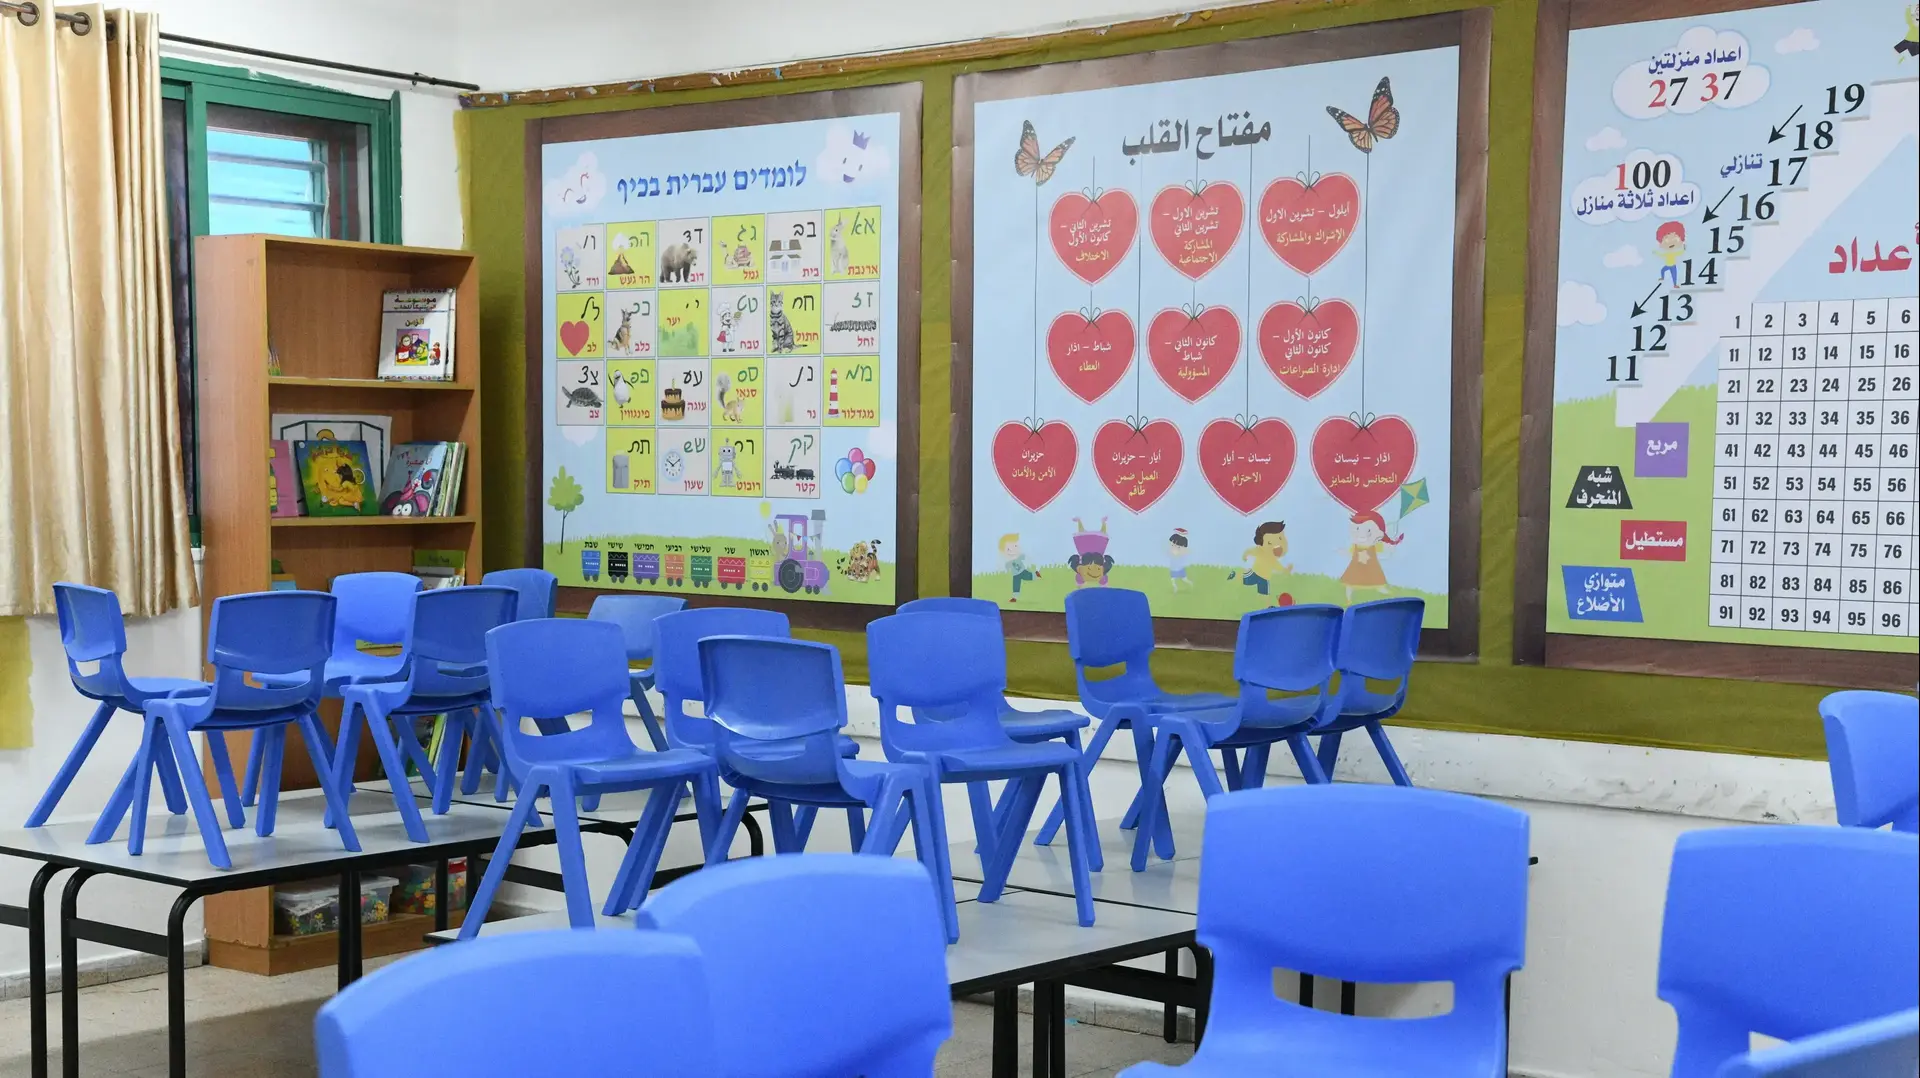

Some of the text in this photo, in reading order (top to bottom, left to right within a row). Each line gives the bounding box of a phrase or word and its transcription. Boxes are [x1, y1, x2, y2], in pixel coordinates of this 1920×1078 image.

[1648, 46, 1742, 75] اعداد منزلتين
[1648, 70, 1742, 108] 27 37
[1823, 83, 1866, 116] 19
[1122, 110, 1271, 166] مفتاح القلب
[1793, 120, 1834, 152] 18
[1719, 153, 1764, 178] تنازلي
[1767, 156, 1808, 187] 17
[617, 159, 807, 205] לומדים עברית בכיף
[1614, 160, 1672, 191] 100
[1576, 196, 1614, 216] منازل
[1617, 190, 1654, 210] ثلاثة
[1737, 191, 1775, 222] 16
[1174, 221, 1193, 238] الثاني
[1707, 225, 1745, 255] 15
[690, 272, 705, 283] דוב
[743, 269, 760, 280] גמל
[802, 267, 820, 278] בית
[847, 264, 879, 276] ארנבת
[1680, 257, 1719, 287] 14
[586, 277, 600, 286] ורד
[619, 276, 651, 286] הר געש
[1657, 293, 1694, 322] 13
[666, 316, 682, 327] יער
[1735, 310, 1911, 329] 1 2 3 4 5 6
[739, 339, 760, 350] טבח
[795, 330, 820, 343] חתול
[857, 335, 875, 348] זחל
[1174, 334, 1218, 352] كانون الثاني
[1307, 328, 1331, 344] كانون
[1630, 324, 1668, 352] 12
[586, 343, 597, 353] לב
[634, 341, 651, 352] כלב
[1092, 340, 1113, 353] شباط
[1285, 342, 1331, 360] كانون الثاني
[1729, 344, 1910, 362] 11 12 13 14 15 16
[1182, 350, 1203, 362] شباط
[1079, 360, 1100, 372] العطاء
[1605, 355, 1640, 382] 11
[735, 388, 757, 398] סנאי
[1727, 377, 1911, 394] 21 22 23 24 25 26
[589, 409, 600, 419] צב
[619, 409, 651, 421] פינגווין
[686, 402, 707, 412] עוגה
[806, 410, 817, 420] נר
[841, 407, 875, 420] מגדלור
[1725, 411, 1910, 426] 31 32 33 34 35 36
[1021, 450, 1045, 463] حزيران
[1646, 439, 1678, 457] مربع
[1724, 444, 1909, 459] 41 42 43 44 45 46
[1248, 453, 1272, 465] نيسان
[1334, 453, 1360, 467] نيسان
[633, 479, 651, 490] תיק
[683, 479, 704, 492] שעון
[735, 480, 761, 491] רובוט
[1115, 470, 1159, 485] العمل ضمن
[1586, 467, 1614, 488] شبه
[1723, 477, 1907, 493] 51 52 53 54 55 56
[795, 482, 817, 495] קטר
[1576, 488, 1622, 509] المنحرف
[1722, 508, 1906, 526] 61 62 63 64 65 66
[1625, 529, 1684, 551] مستطيل
[584, 541, 770, 558] ראשון שני שלישי רביעי חמישי שישי שבת
[1721, 540, 1903, 559] 71 72 73 74 75 76
[1584, 572, 1626, 593] متوازي
[1720, 574, 1903, 595] 81 82 83 84 85 86
[1576, 593, 1626, 616] الأضلاع
[1719, 606, 1901, 628] 91 92 93 94 95 96
